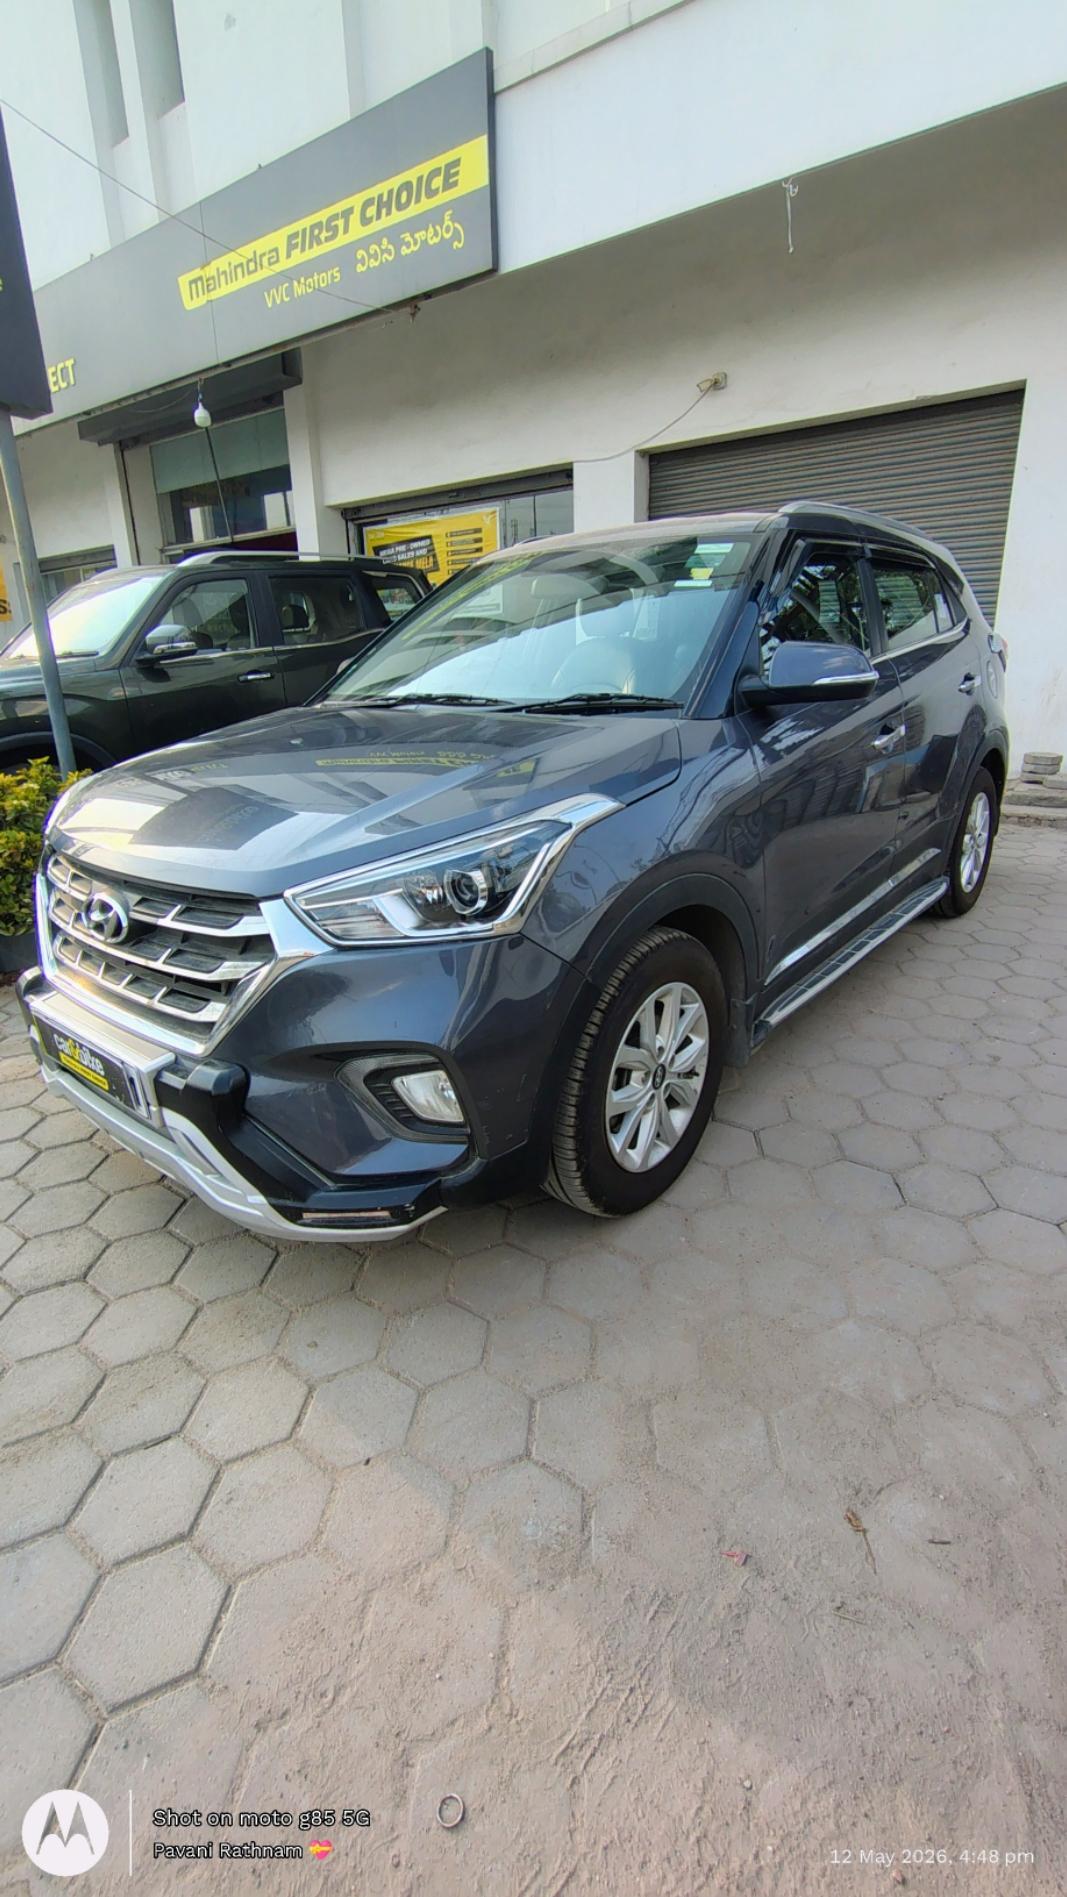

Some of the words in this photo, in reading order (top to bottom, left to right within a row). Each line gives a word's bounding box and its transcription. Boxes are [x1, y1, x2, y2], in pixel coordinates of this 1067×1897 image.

[188, 246, 280, 302] Mahindra
[285, 206, 355, 260] FIRST
[360, 157, 461, 228] CHOICE
[264, 283, 291, 308] VVC
[293, 266, 341, 298] Motors
